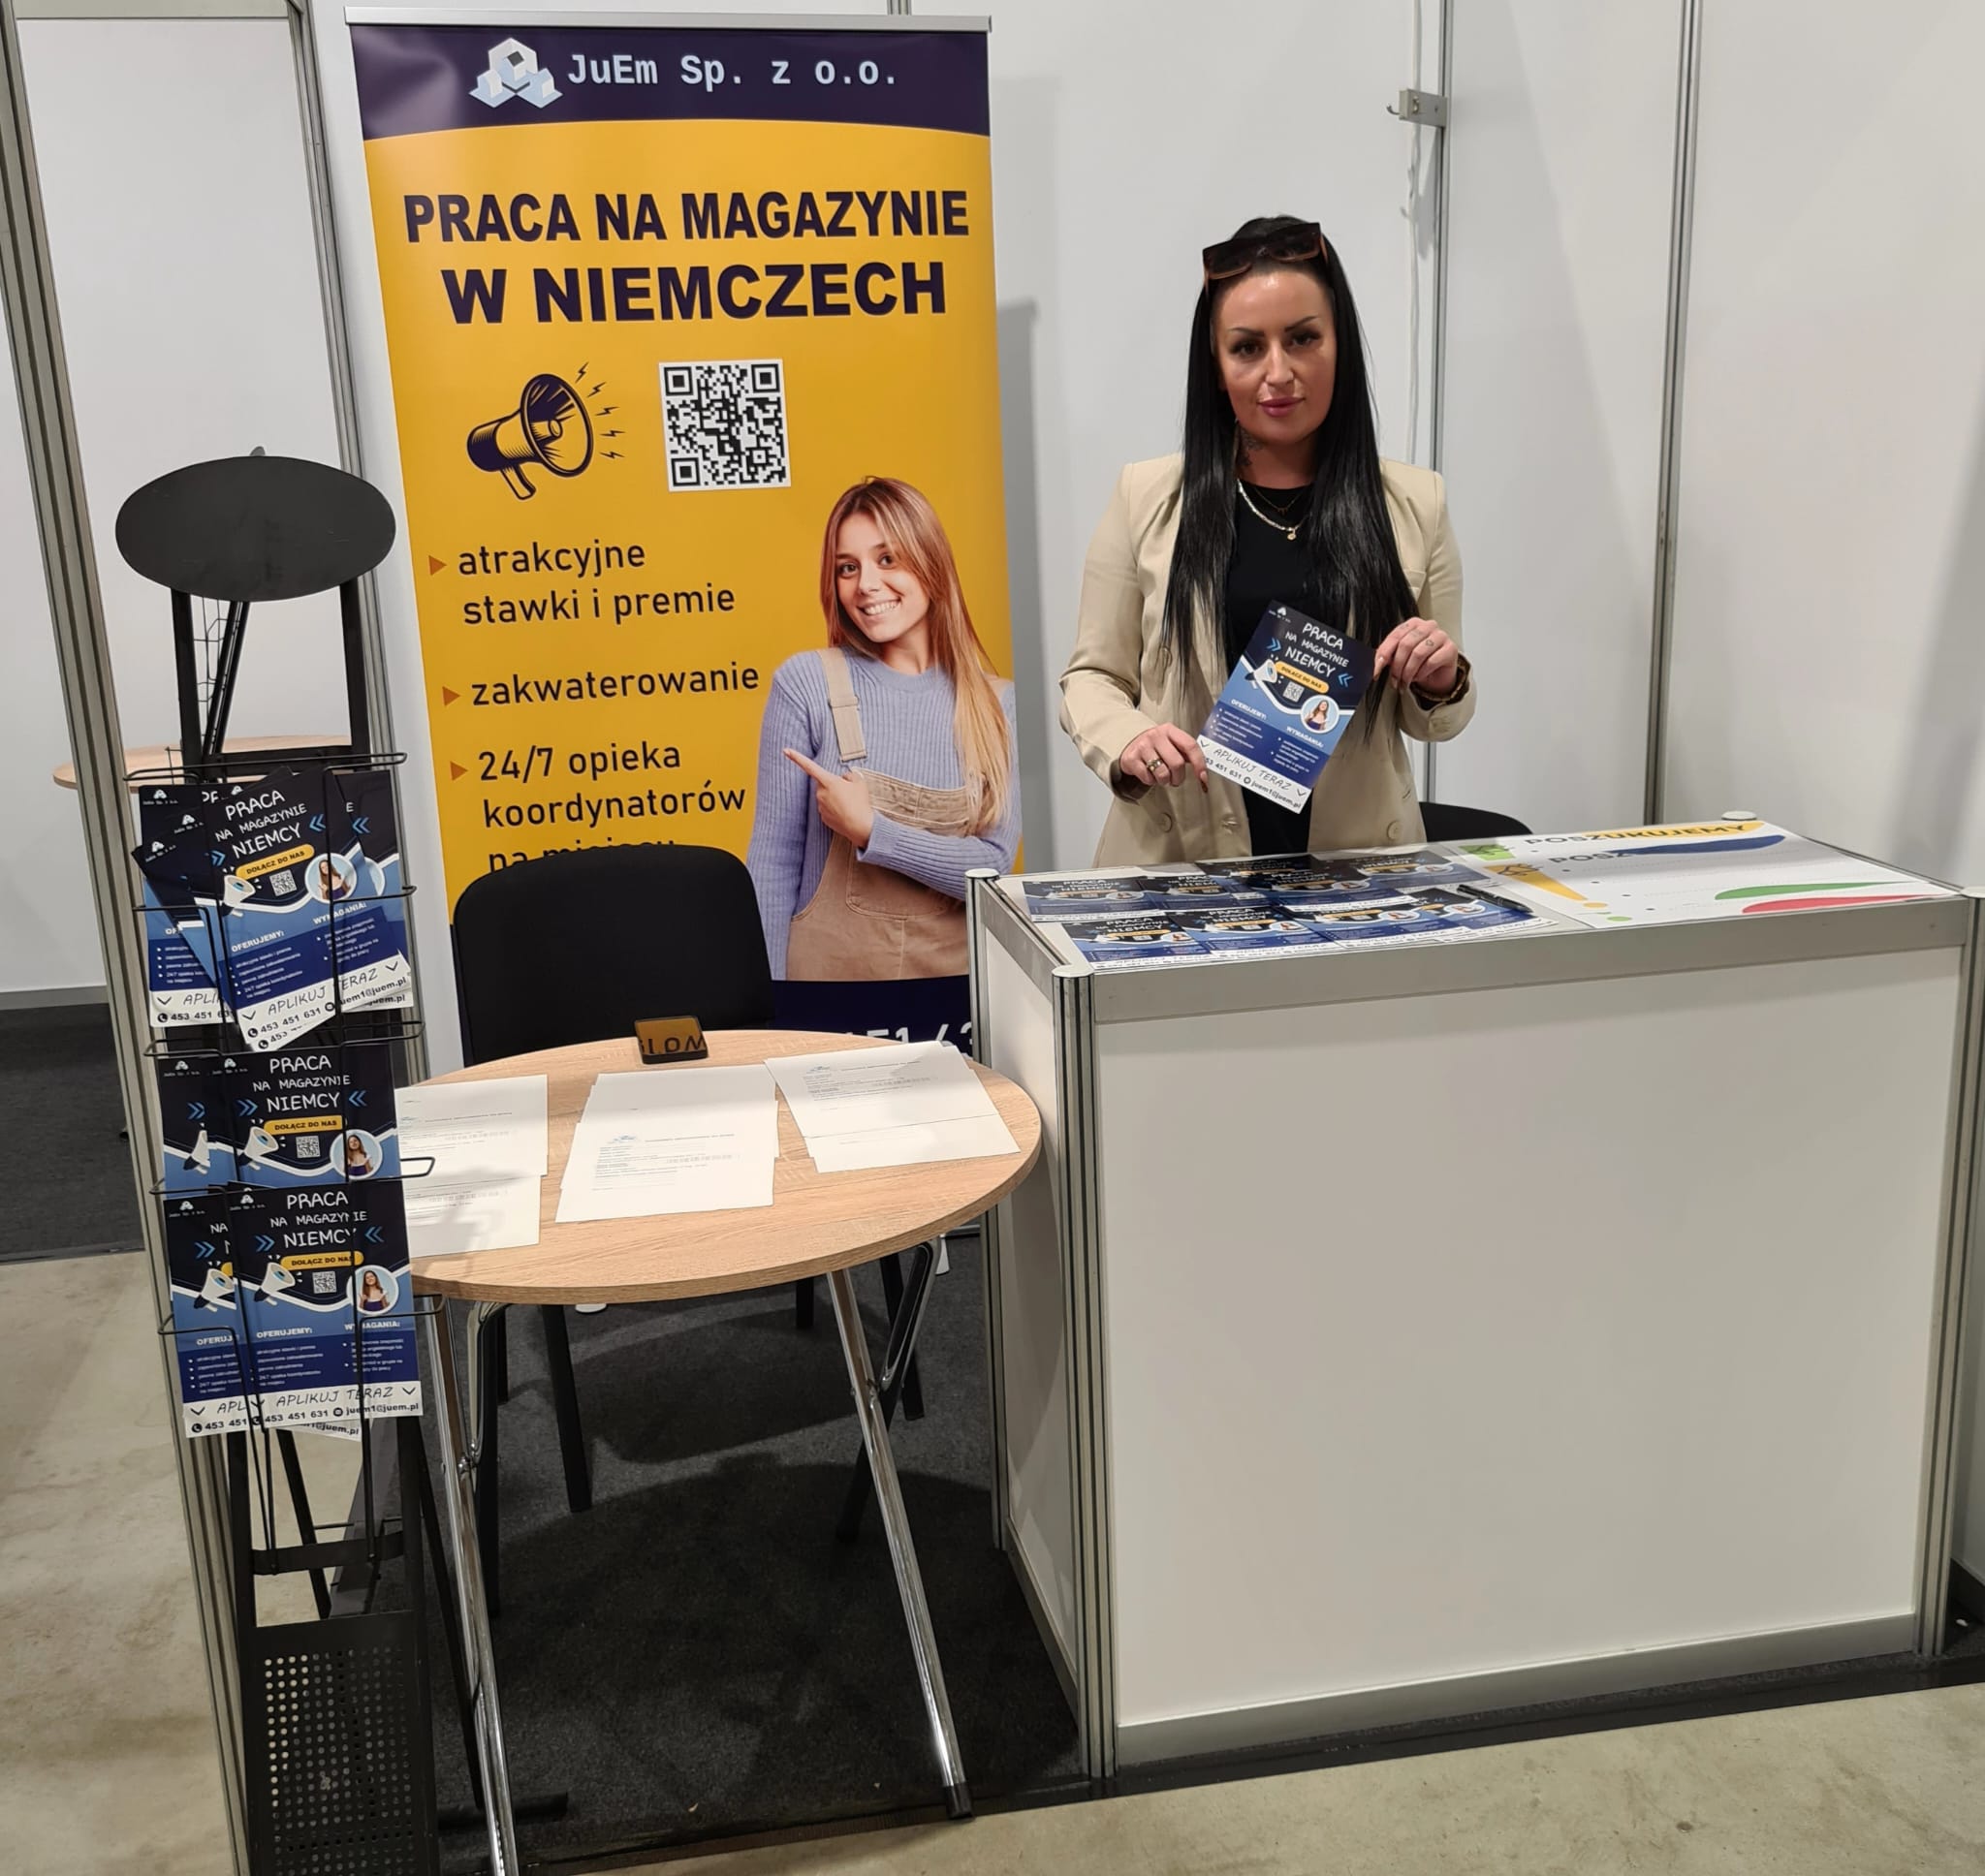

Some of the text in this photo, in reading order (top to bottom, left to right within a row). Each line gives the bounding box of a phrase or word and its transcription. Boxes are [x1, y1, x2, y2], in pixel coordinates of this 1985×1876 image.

[568, 54, 898, 91] JuEm Sp. z o.o.
[403, 190, 969, 243] PRACA NA MAGAZYNIE
[441, 262, 946, 325] W NIEMCZECH
[458, 539, 646, 578] atrakcyjne
[463, 582, 735, 625] stawki i premie
[1302, 623, 1344, 651] PRACA
[1284, 646, 1336, 677] NIEMCY
[472, 662, 760, 706] zakwaterowanie
[479, 741, 680, 784] 24/7 opieka
[1213, 748, 1257, 773] APLIKUJ
[1258, 769, 1292, 791] TERAZ
[225, 790, 286, 821] PRACA
[484, 780, 745, 829] koordynatorów
[214, 803, 307, 842] NA MAGAZYNIE
[233, 822, 301, 860] NIEMCY
[268, 985, 327, 1016] APLIKUJ
[260, 1021, 279, 1033] 453
[282, 1015, 300, 1026] 451
[303, 1007, 322, 1018] 631
[269, 1055, 331, 1074] PRACA
[252, 1080, 271, 1092] NA
[267, 1092, 340, 1113] NIEMCY
[287, 1191, 349, 1210] PRACA
[210, 1223, 229, 1235] NA
[269, 1216, 288, 1228] NA
[276, 1391, 339, 1407] APLIKUJ
[205, 1418, 247, 1431] 453 451
[288, 1412, 305, 1421] 451
[310, 1410, 329, 1419] 631
